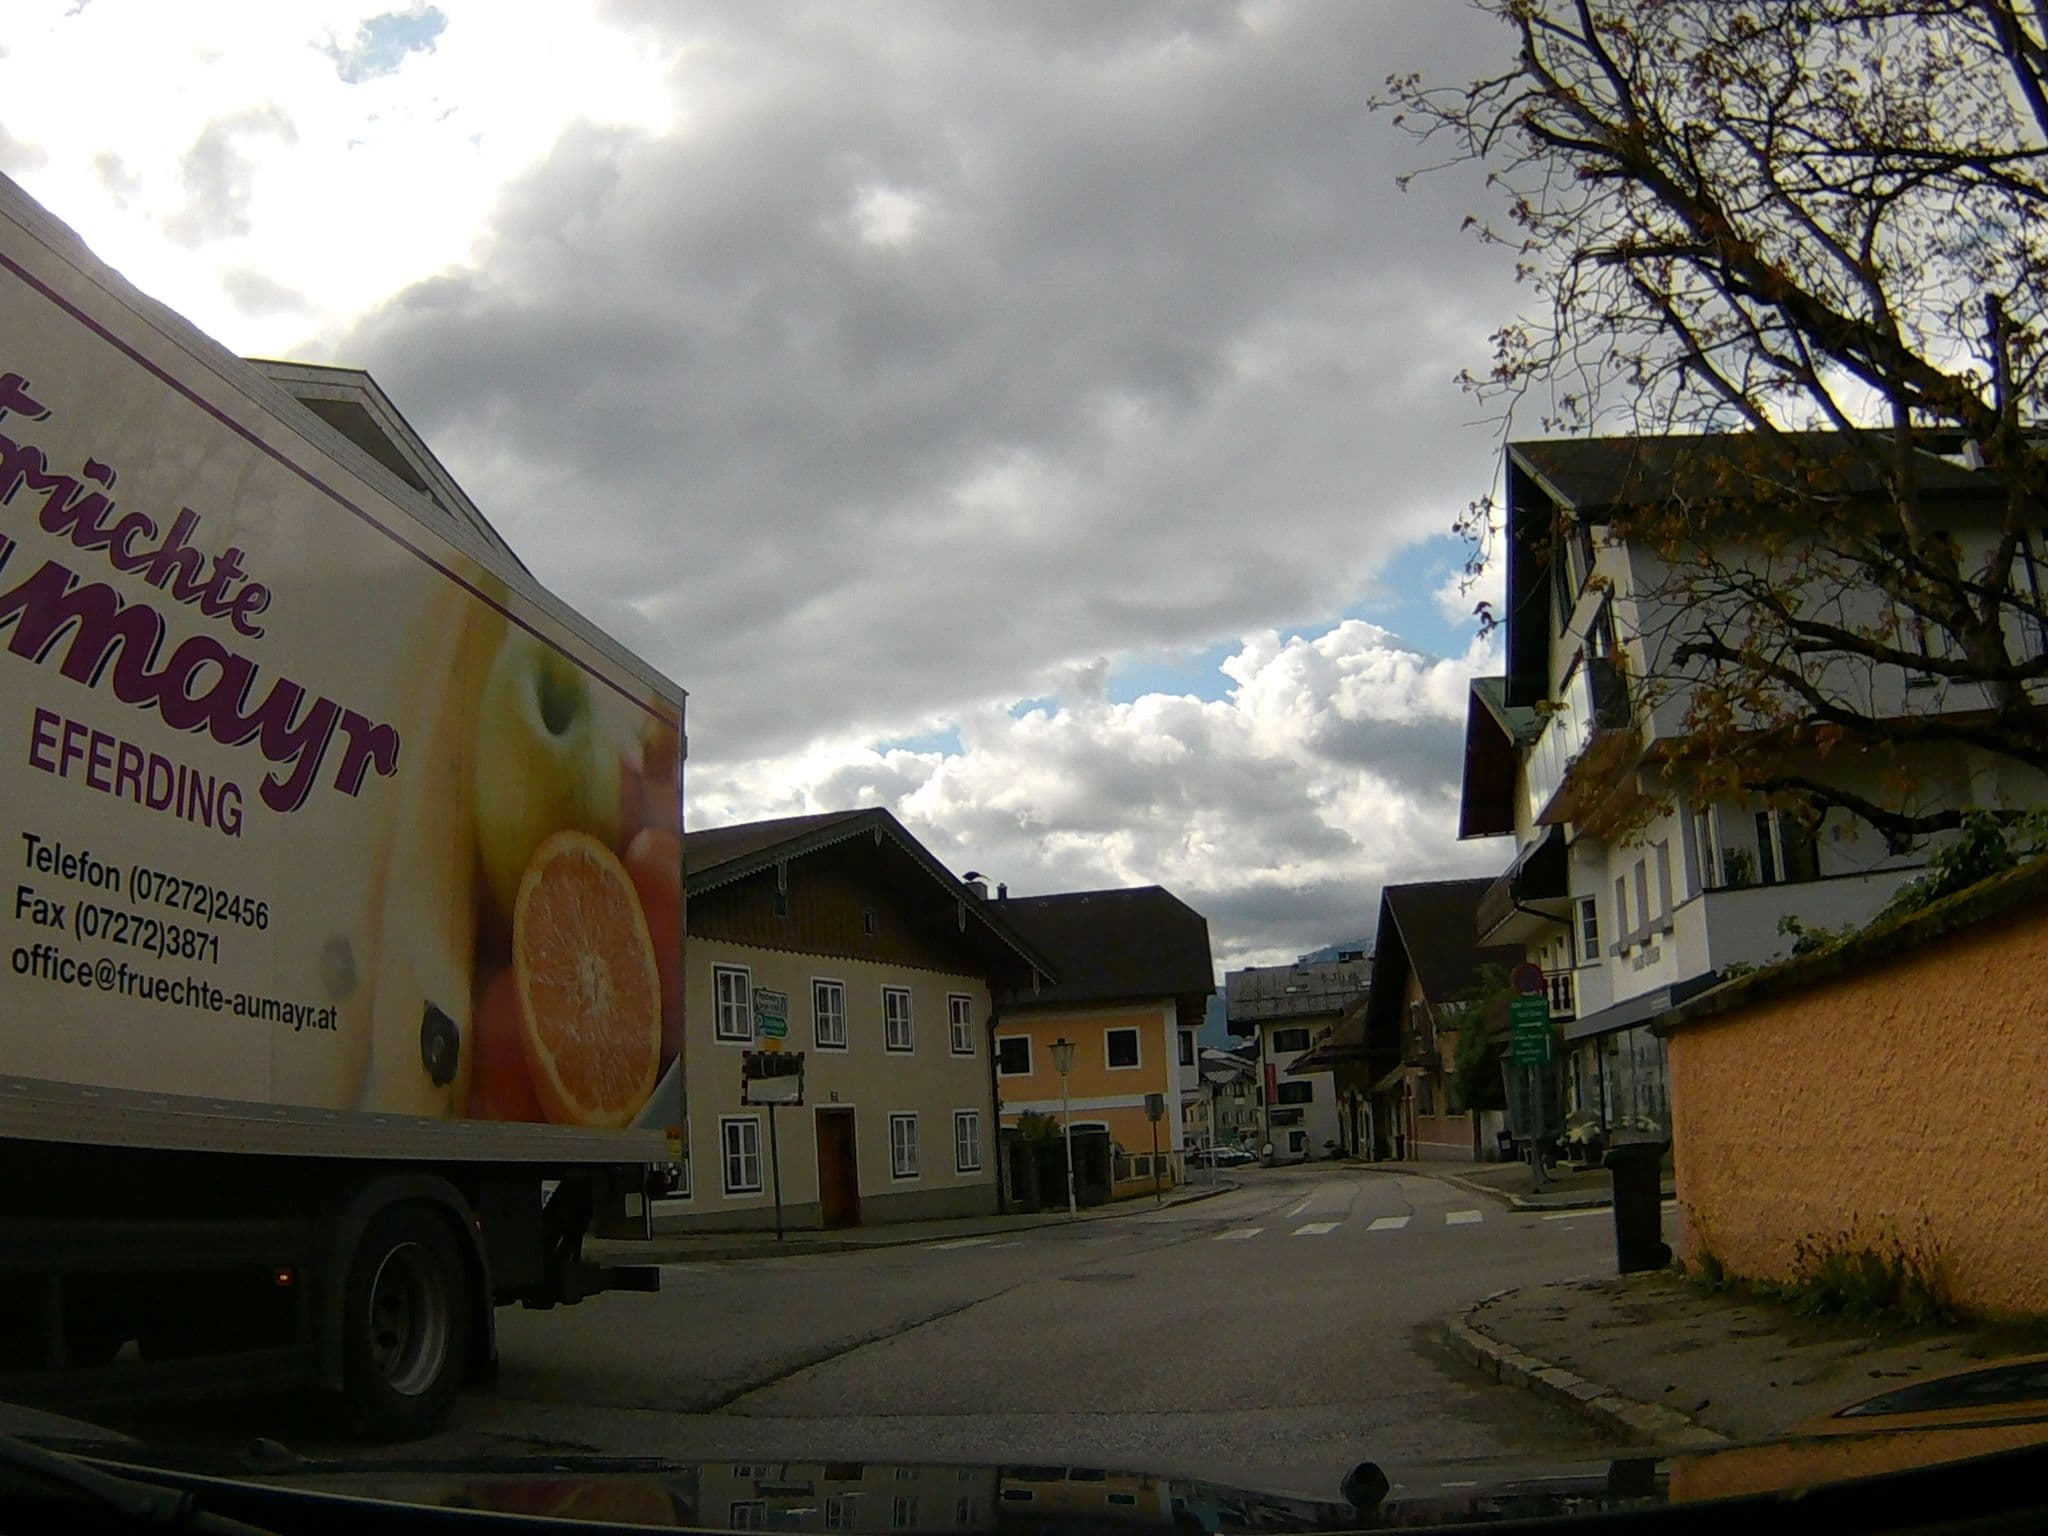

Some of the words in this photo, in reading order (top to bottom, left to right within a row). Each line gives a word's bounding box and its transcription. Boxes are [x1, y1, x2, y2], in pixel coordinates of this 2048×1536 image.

[29, 706, 243, 838] EFERDING
[15, 885, 66, 930] Fax
[74, 901, 220, 964] (07272)3871
[22, 832, 120, 892] Telefon
[129, 865, 269, 930] (07272)2456
[11, 944, 338, 1032] office@fruechte-aumayr.at
